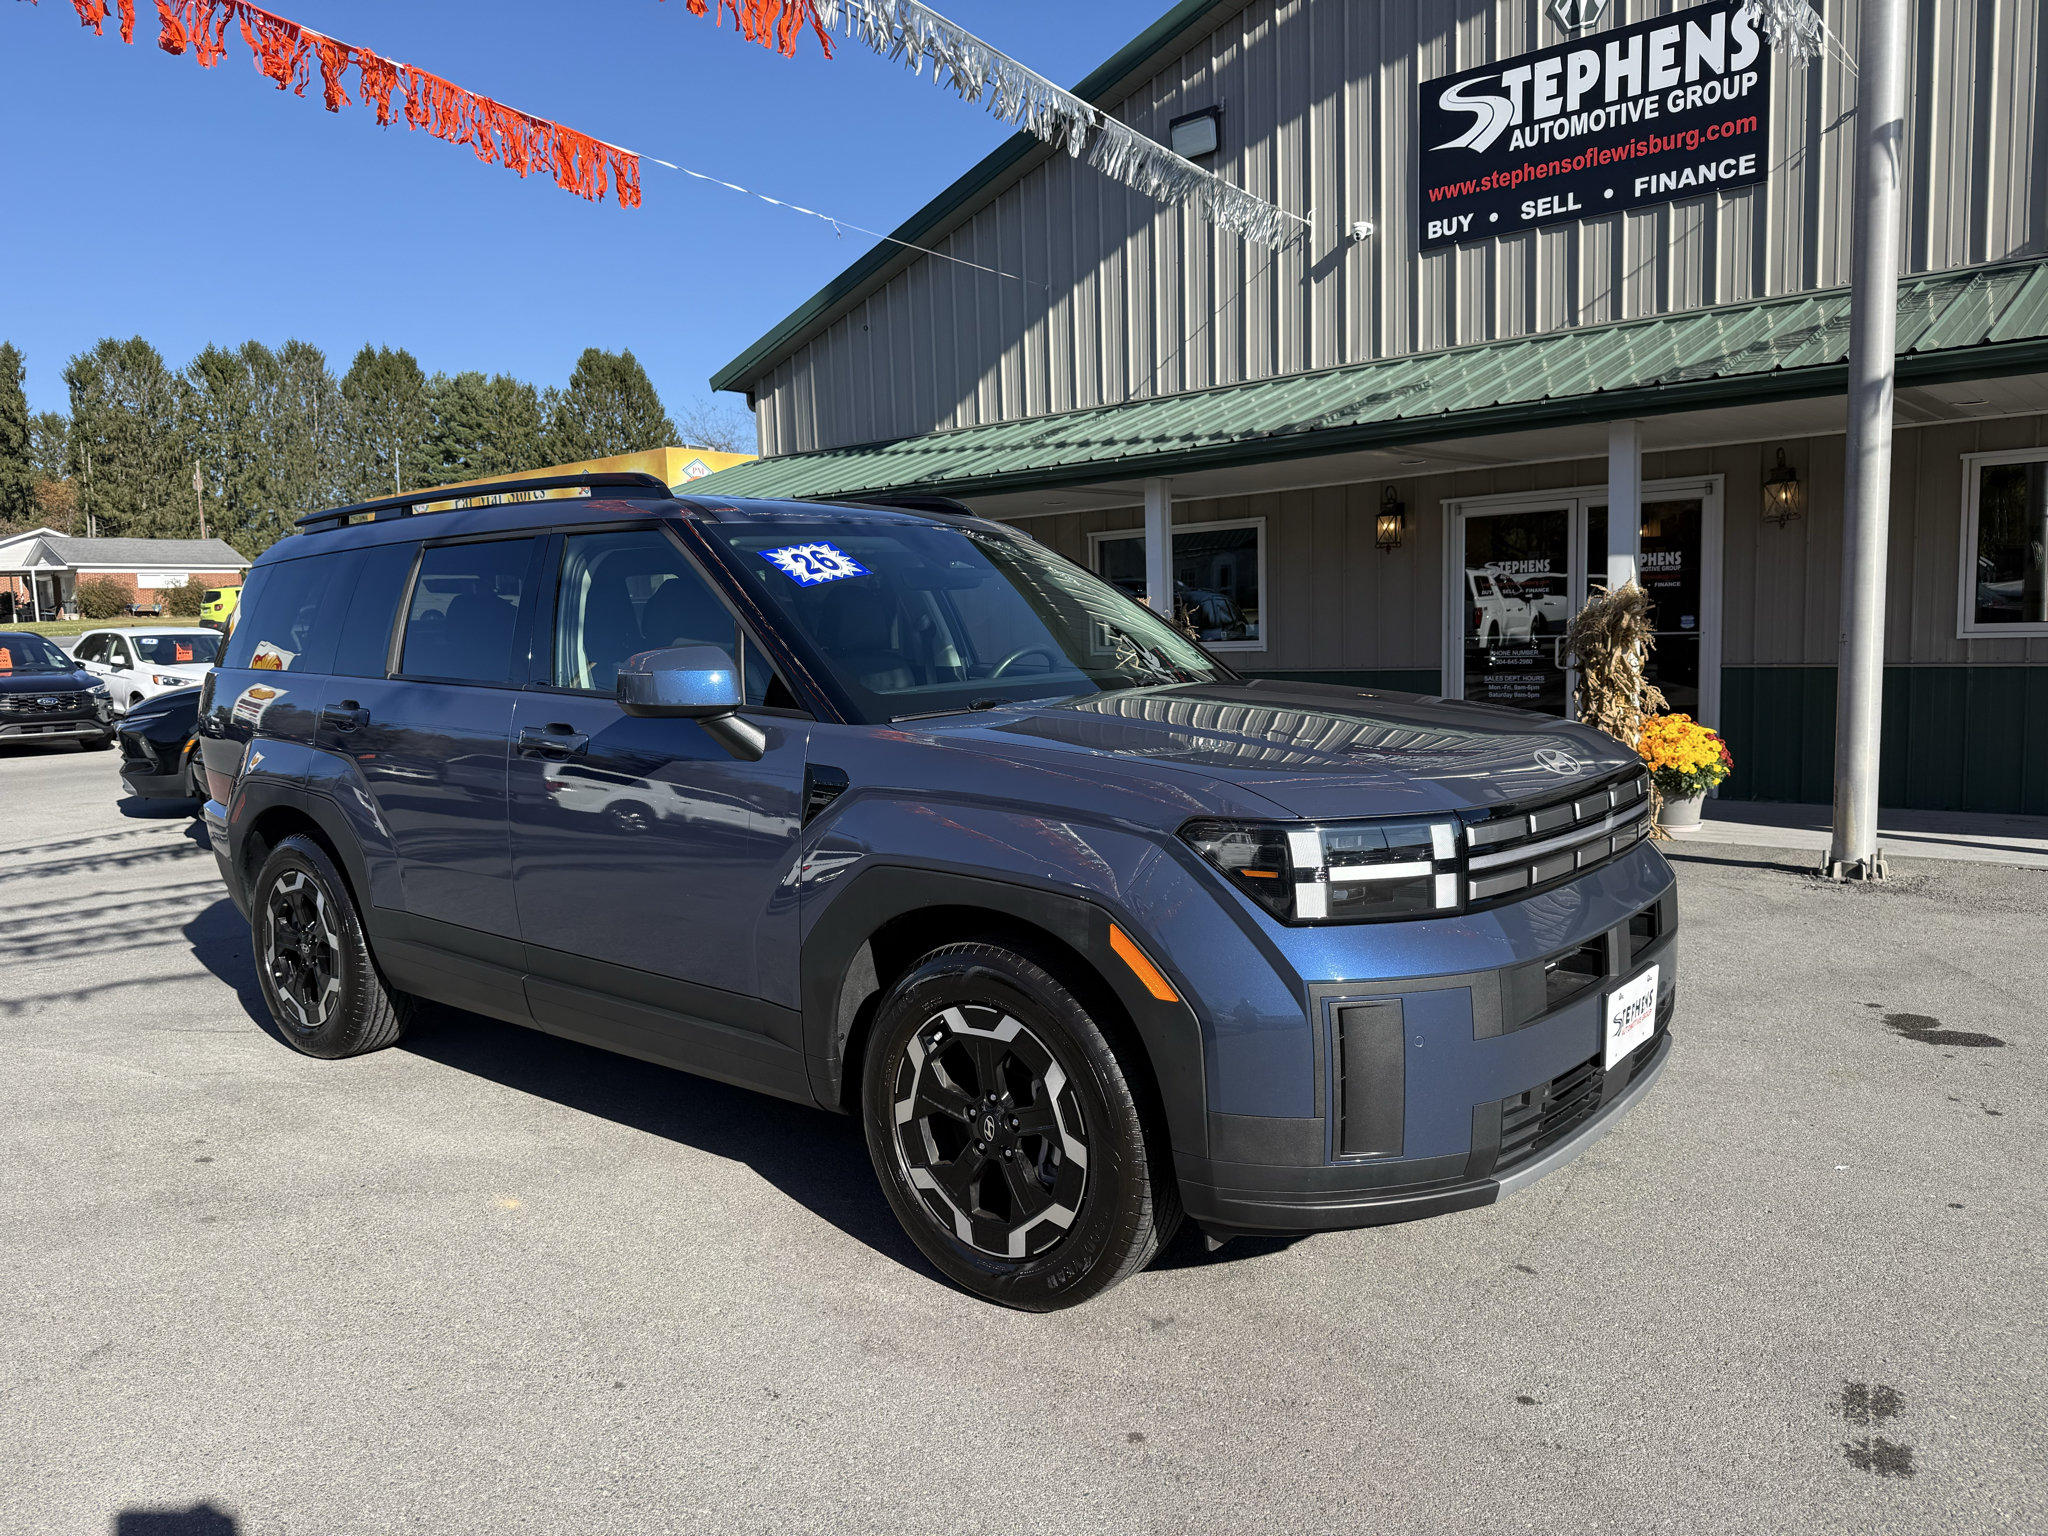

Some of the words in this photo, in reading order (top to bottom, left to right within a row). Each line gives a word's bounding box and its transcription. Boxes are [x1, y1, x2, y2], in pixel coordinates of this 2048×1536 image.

[1428, 5, 1760, 154] STEPHENS
[1508, 95, 1659, 152] AUTOMOTIVE
[1667, 71, 1758, 114] GROUP
[1427, 213, 1474, 240] BUY
[1521, 192, 1582, 220] SELL
[1634, 153, 1756, 198] FINANCE
[1428, 115, 1758, 203] www.stephensoflewisburg.com
[791, 550, 840, 575] 26
[1612, 989, 1653, 1038] STEPHENS
